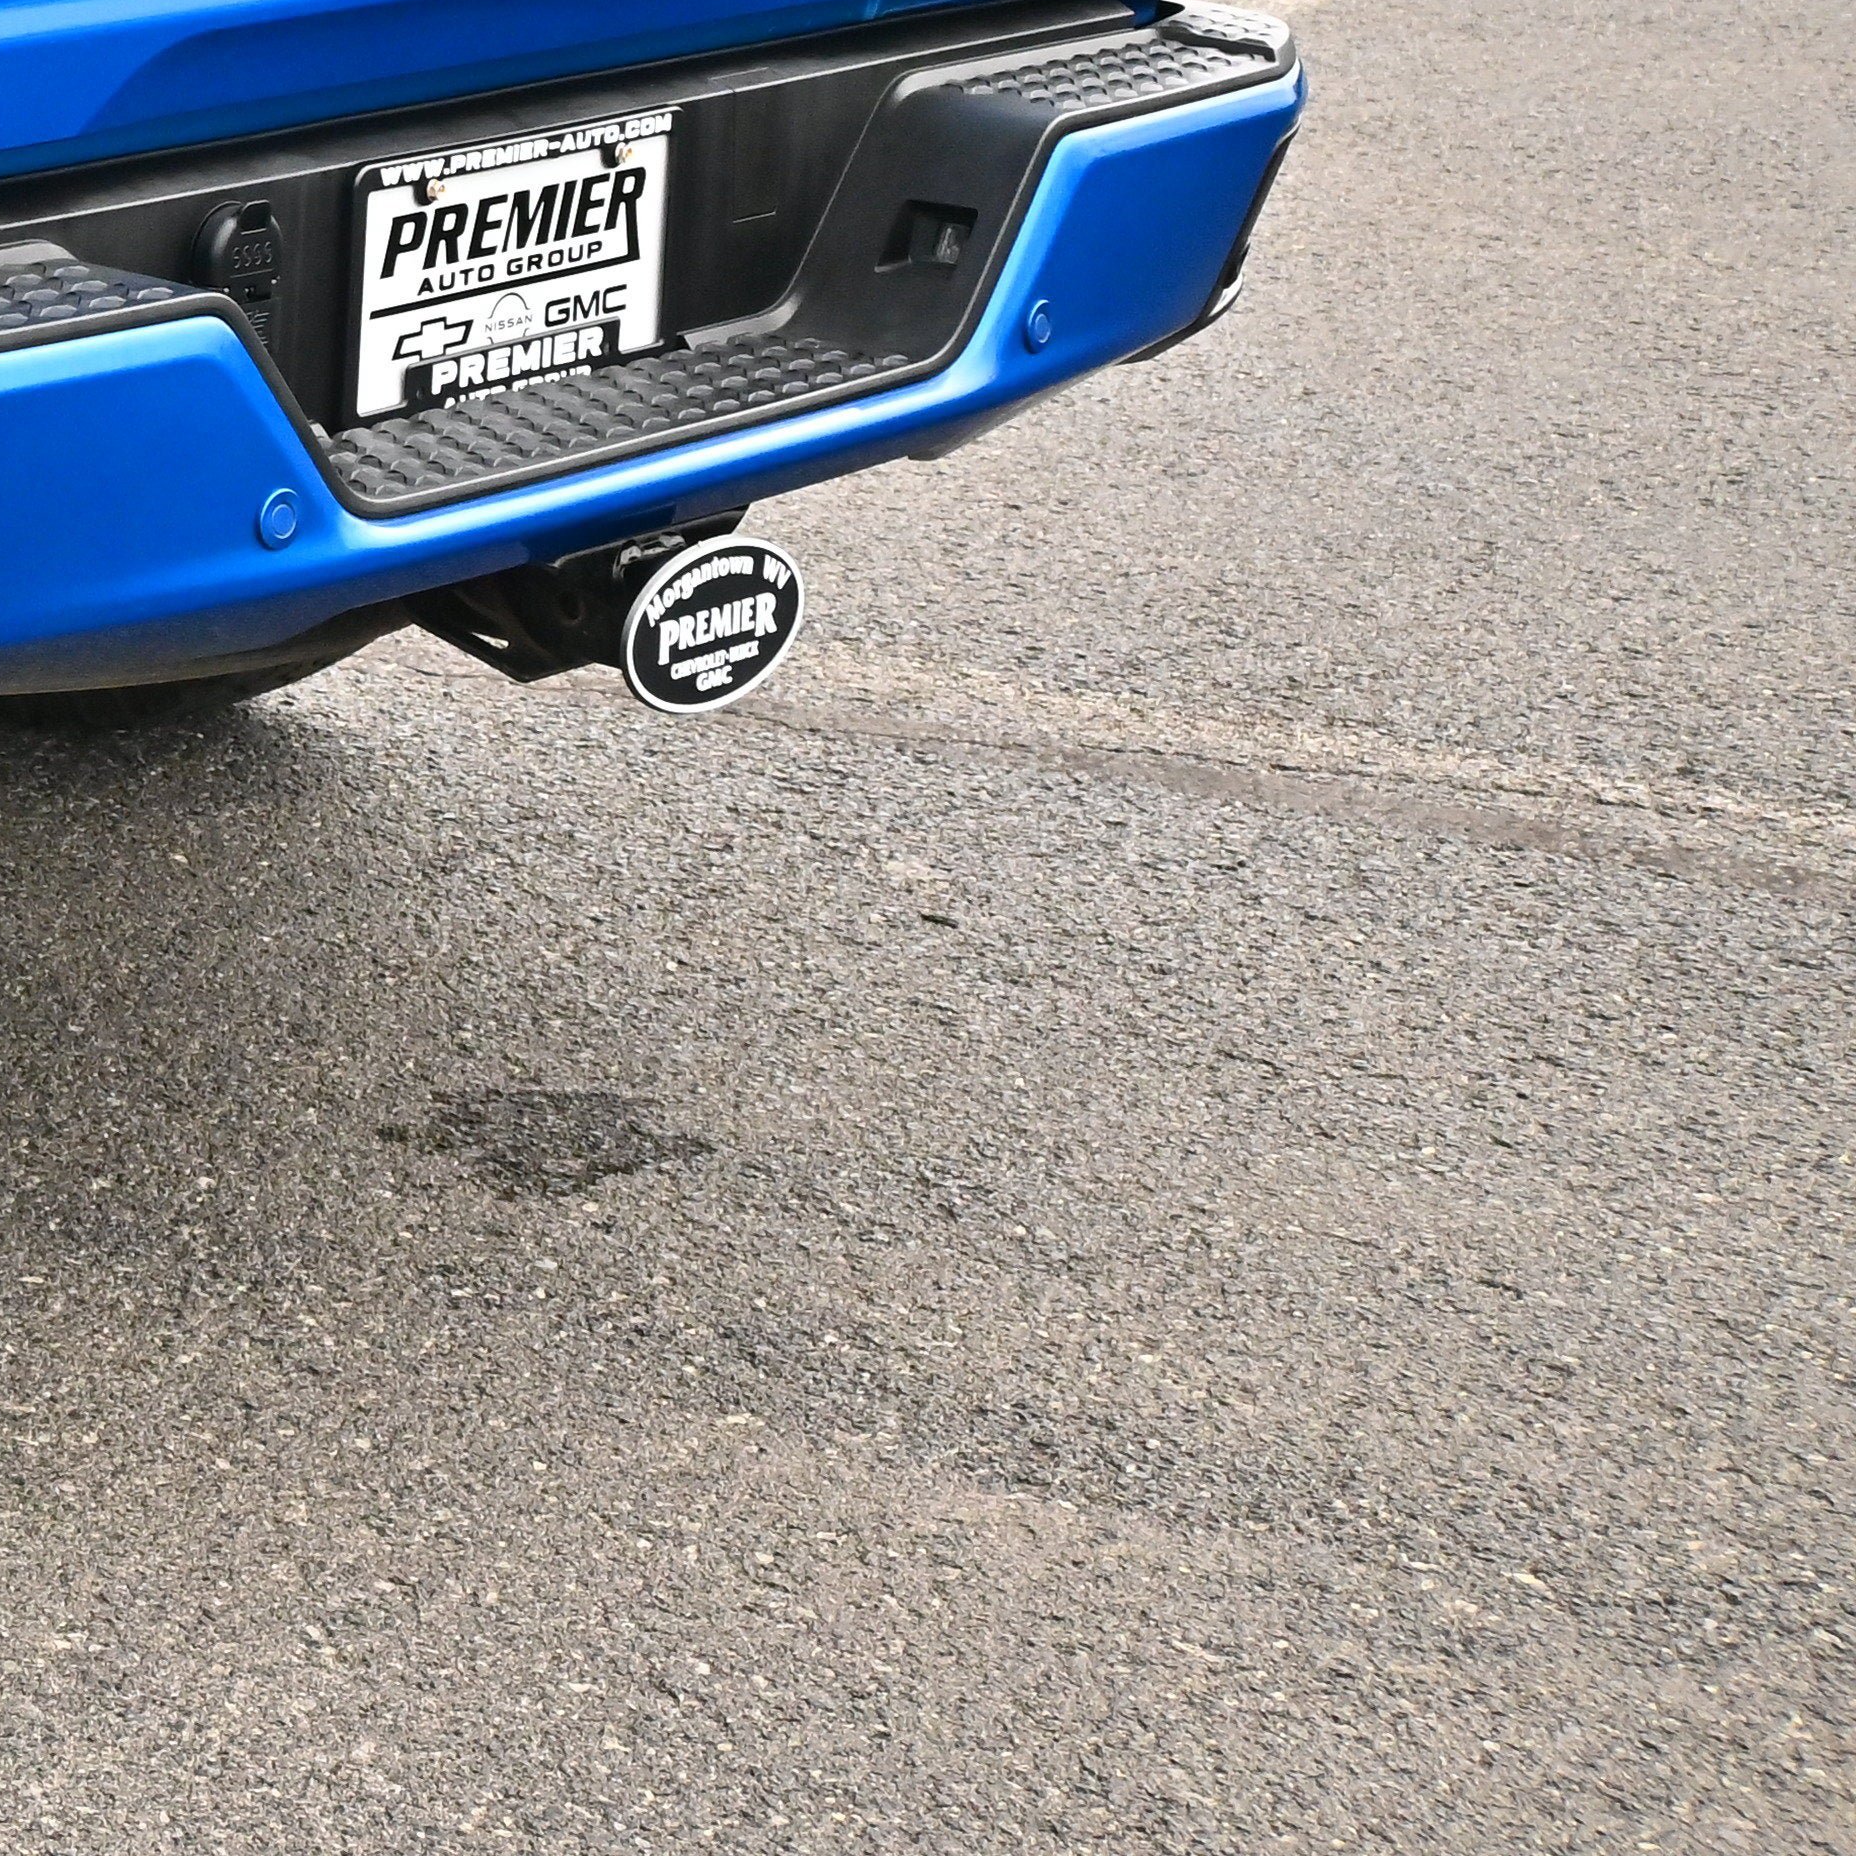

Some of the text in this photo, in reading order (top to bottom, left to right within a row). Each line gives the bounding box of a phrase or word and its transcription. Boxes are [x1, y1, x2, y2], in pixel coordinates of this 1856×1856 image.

[380, 112, 673, 187] WWW.PREMIER-AUTO.COM
[379, 166, 647, 280] PREMIER
[417, 240, 603, 296] AUTO GROUP
[484, 284, 628, 333] NISSAN GMC
[430, 325, 605, 396] PREMIER
[645, 553, 792, 628] Morgantown WV
[657, 591, 778, 666] PREMIER
[695, 665, 734, 692] GMC
